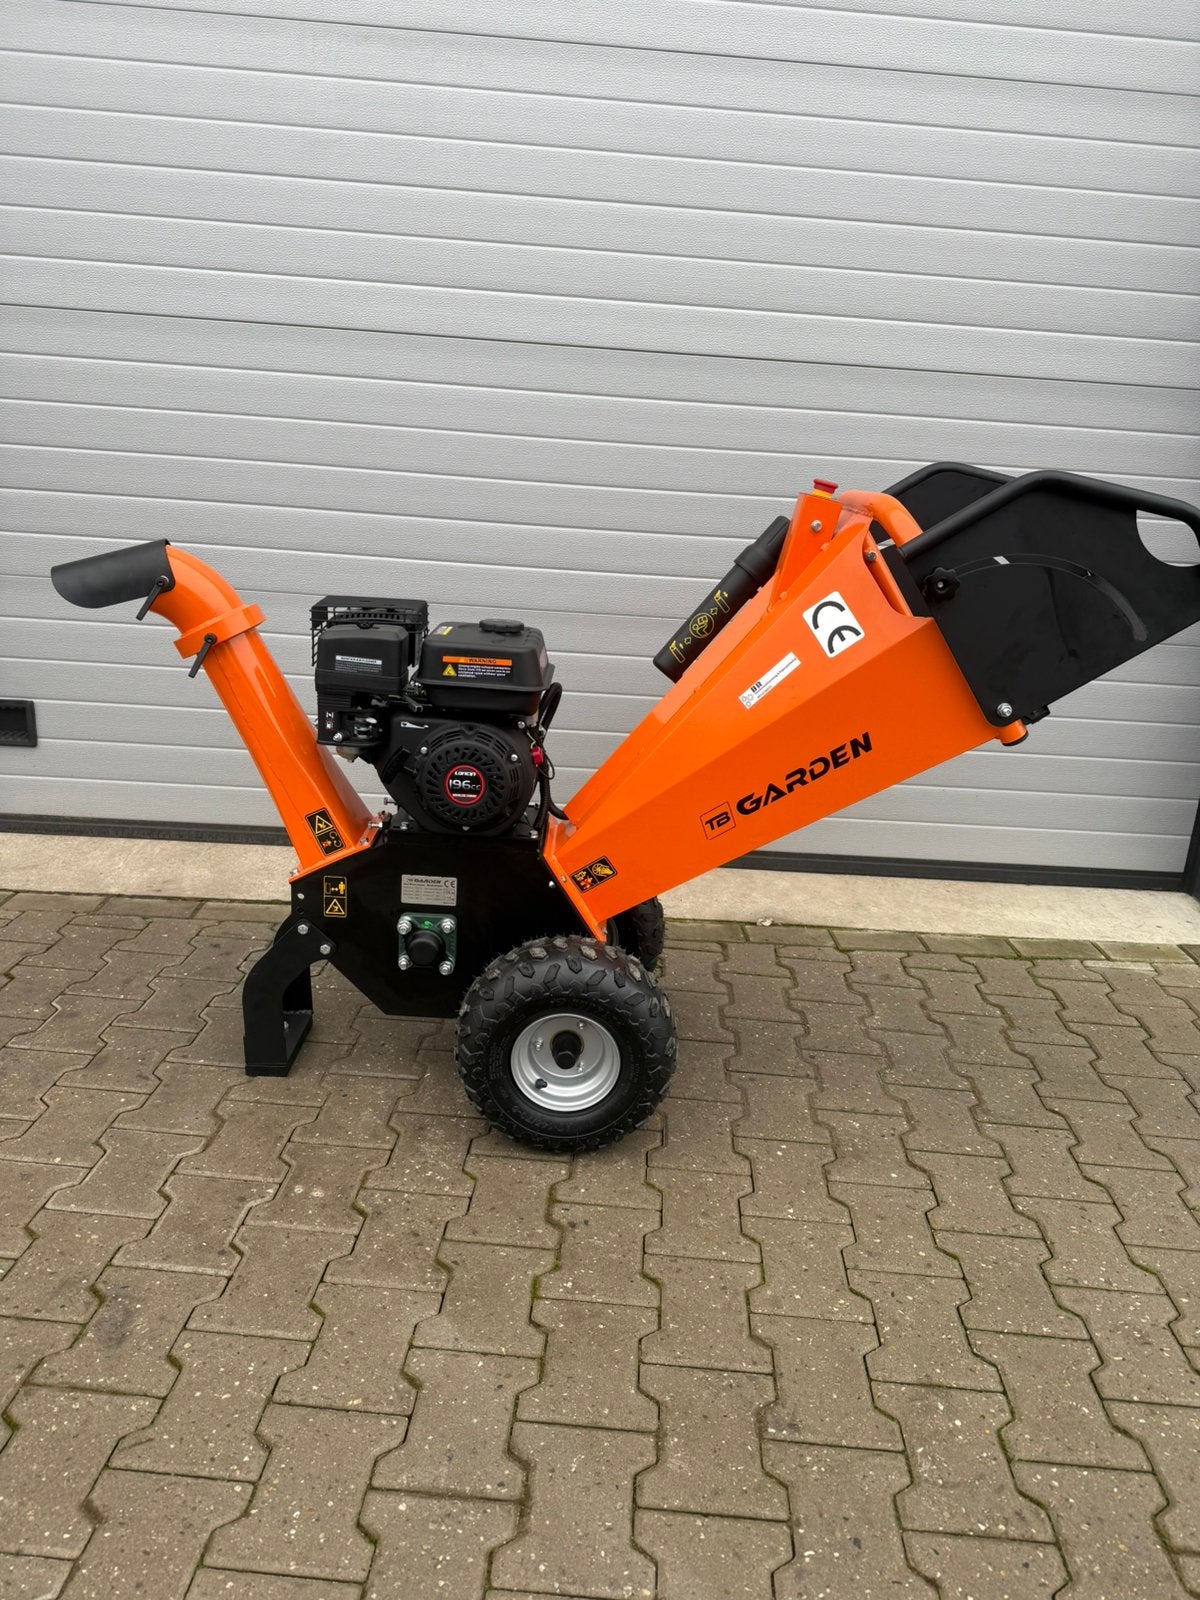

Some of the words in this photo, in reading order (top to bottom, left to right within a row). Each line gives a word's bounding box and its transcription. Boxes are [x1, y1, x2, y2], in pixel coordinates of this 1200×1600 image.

[449, 779, 481, 790] 196cc
[705, 811, 731, 831] TB
[736, 731, 873, 816] GARDEN
